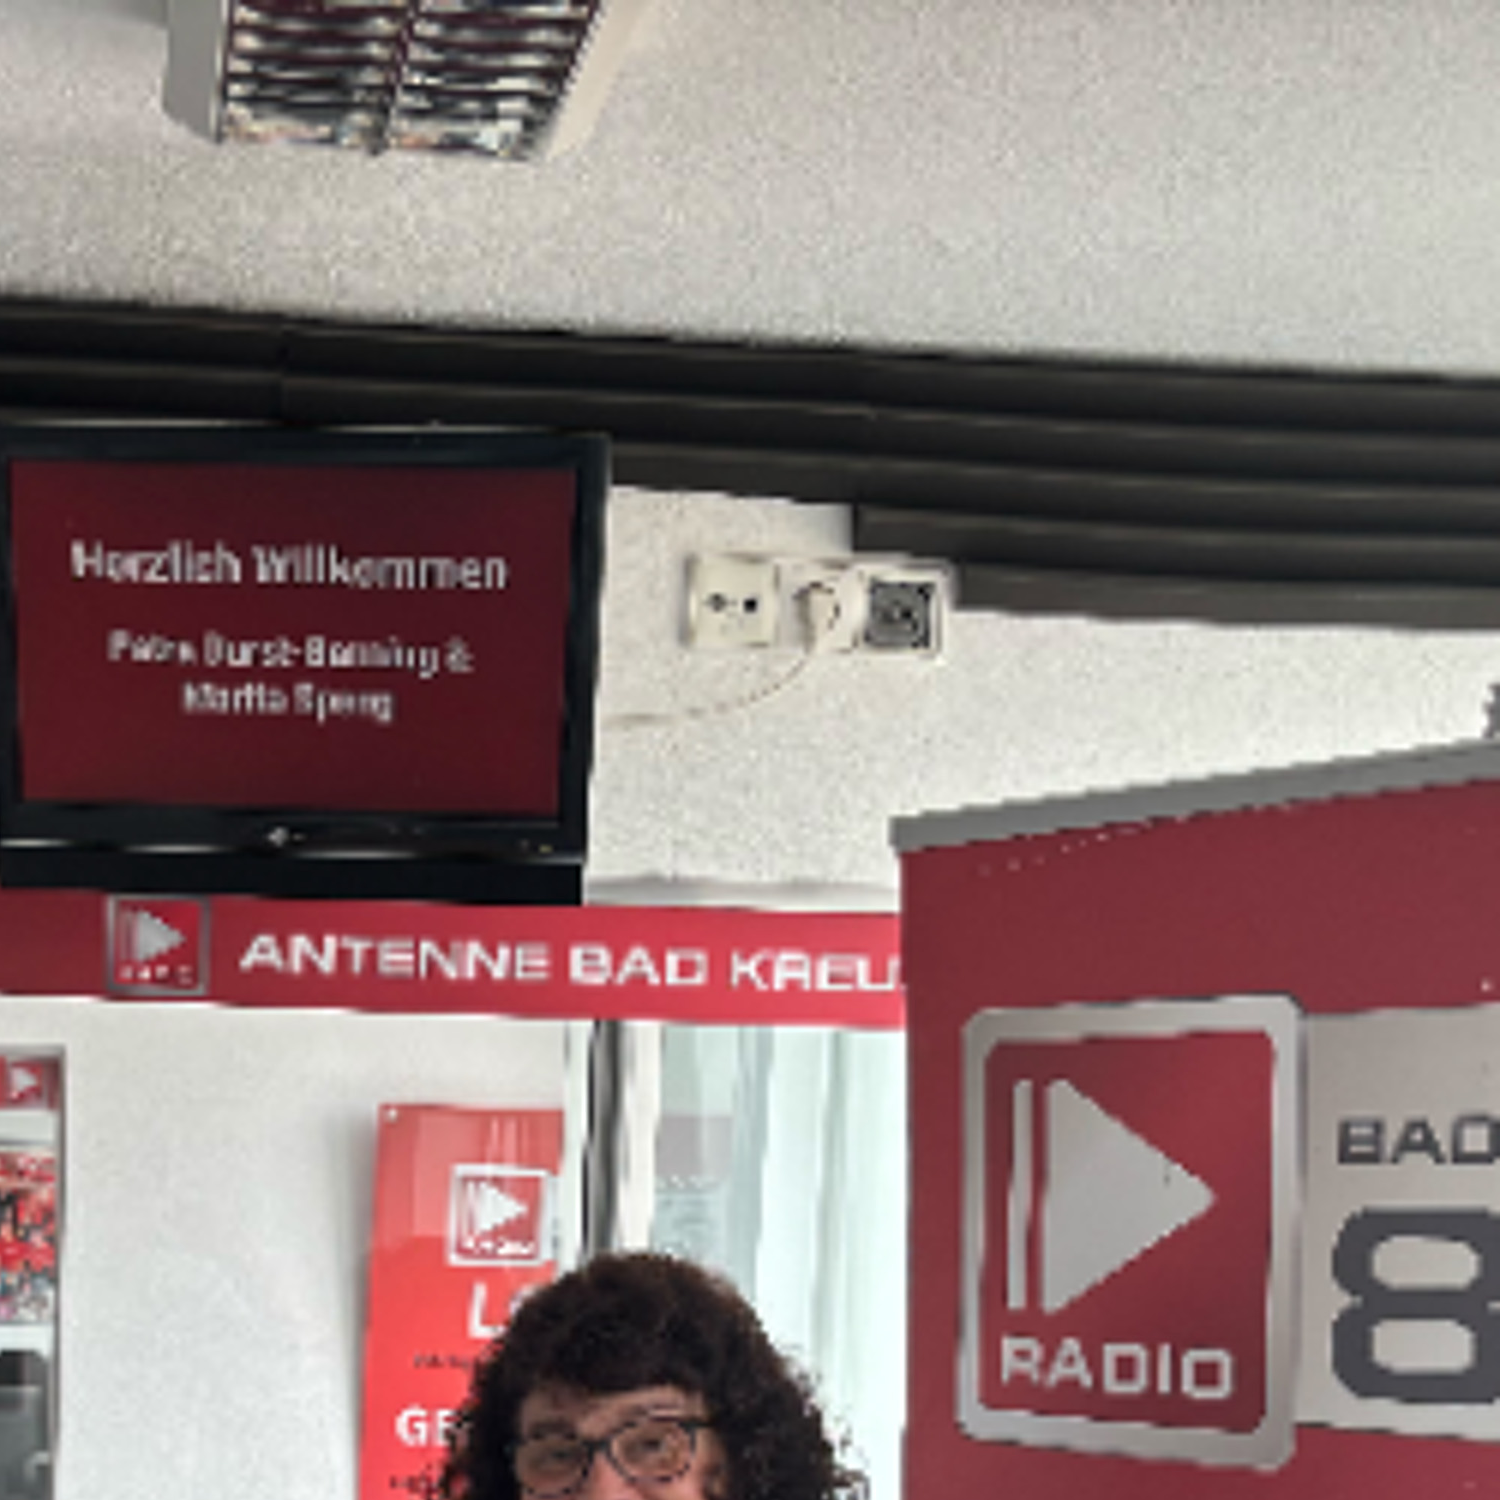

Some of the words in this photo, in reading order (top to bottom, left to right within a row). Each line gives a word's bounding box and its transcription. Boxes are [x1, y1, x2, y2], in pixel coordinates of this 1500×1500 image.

[69, 539, 243, 584] Herzlich
[250, 544, 508, 590] Willkommen
[239, 934, 551, 981] ANTENNE
[568, 942, 707, 986] BAD
[729, 948, 905, 992] KREU
[1337, 1116, 1500, 1164] BAD
[1000, 1335, 1234, 1400] RADIO
